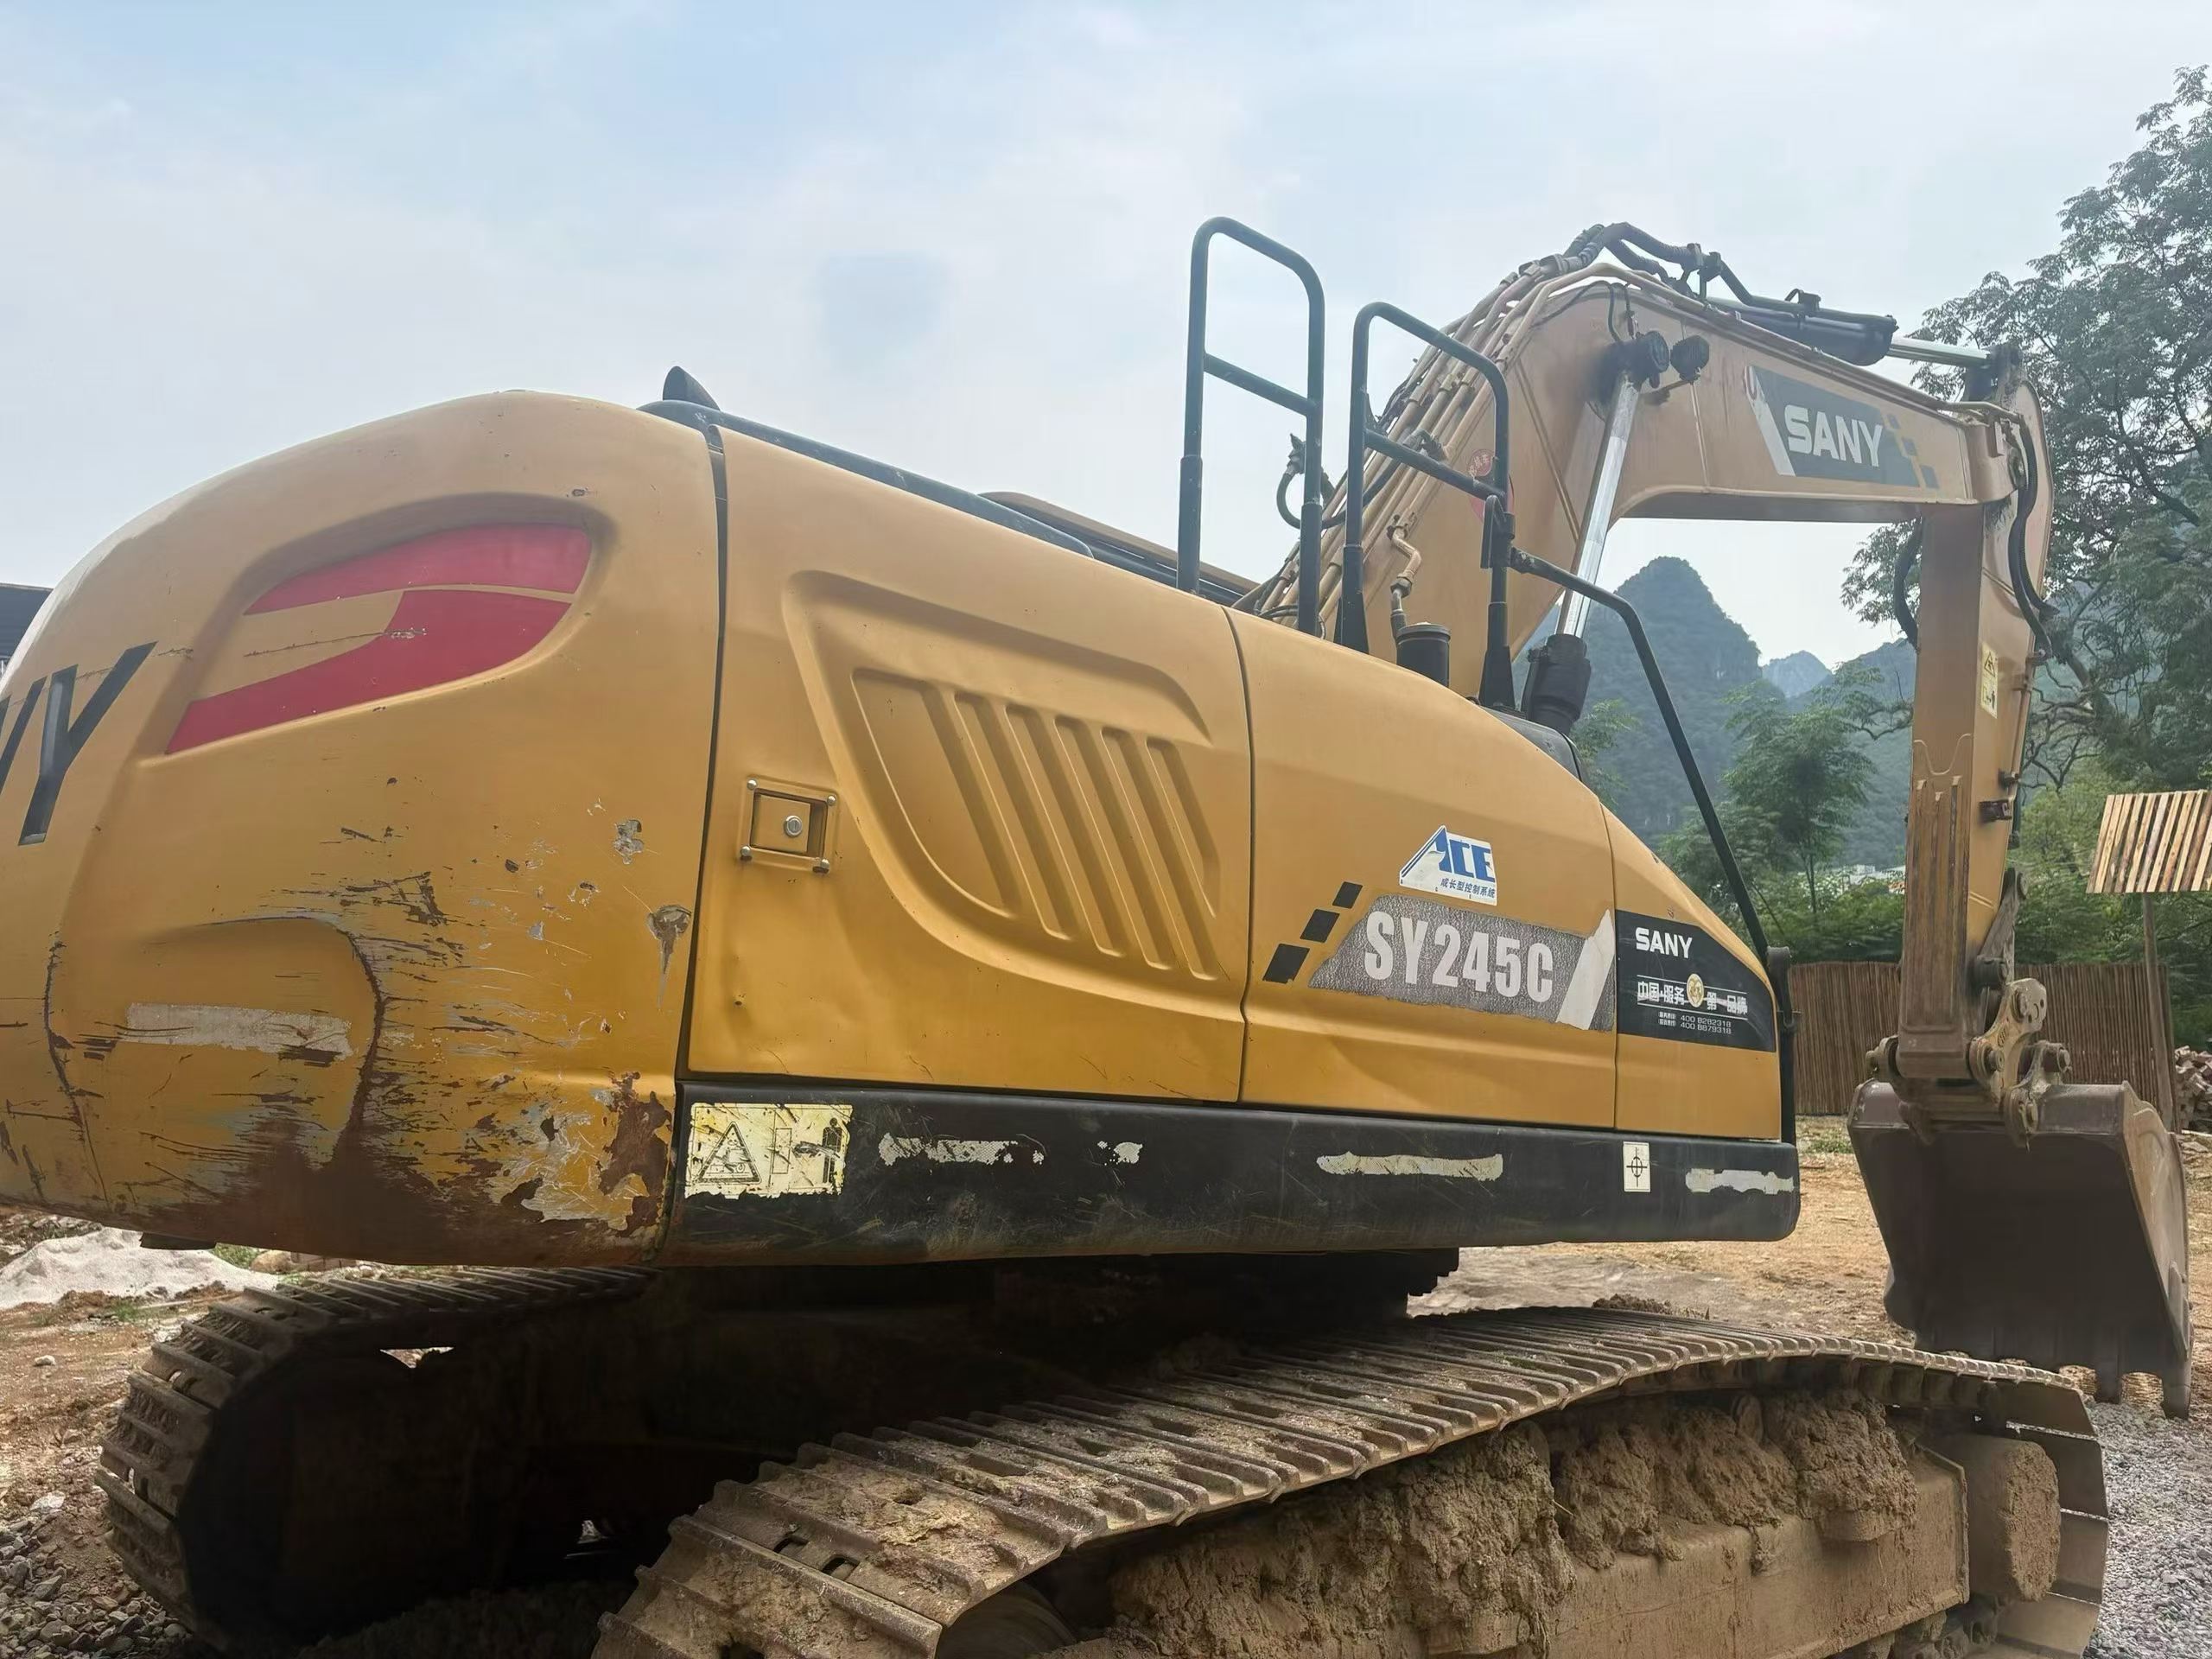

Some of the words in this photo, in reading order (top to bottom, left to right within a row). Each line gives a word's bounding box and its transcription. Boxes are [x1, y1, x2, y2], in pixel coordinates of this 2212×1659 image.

[1784, 404, 1883, 467] SANY
[1401, 827, 1496, 883] ACE
[1440, 877, 1496, 899] 成长型控制系统
[1364, 911, 1554, 1003] SY245C
[1635, 927, 1693, 959] SANY
[1680, 1014, 1695, 1023] 400
[1680, 1021, 1695, 1030] 400
